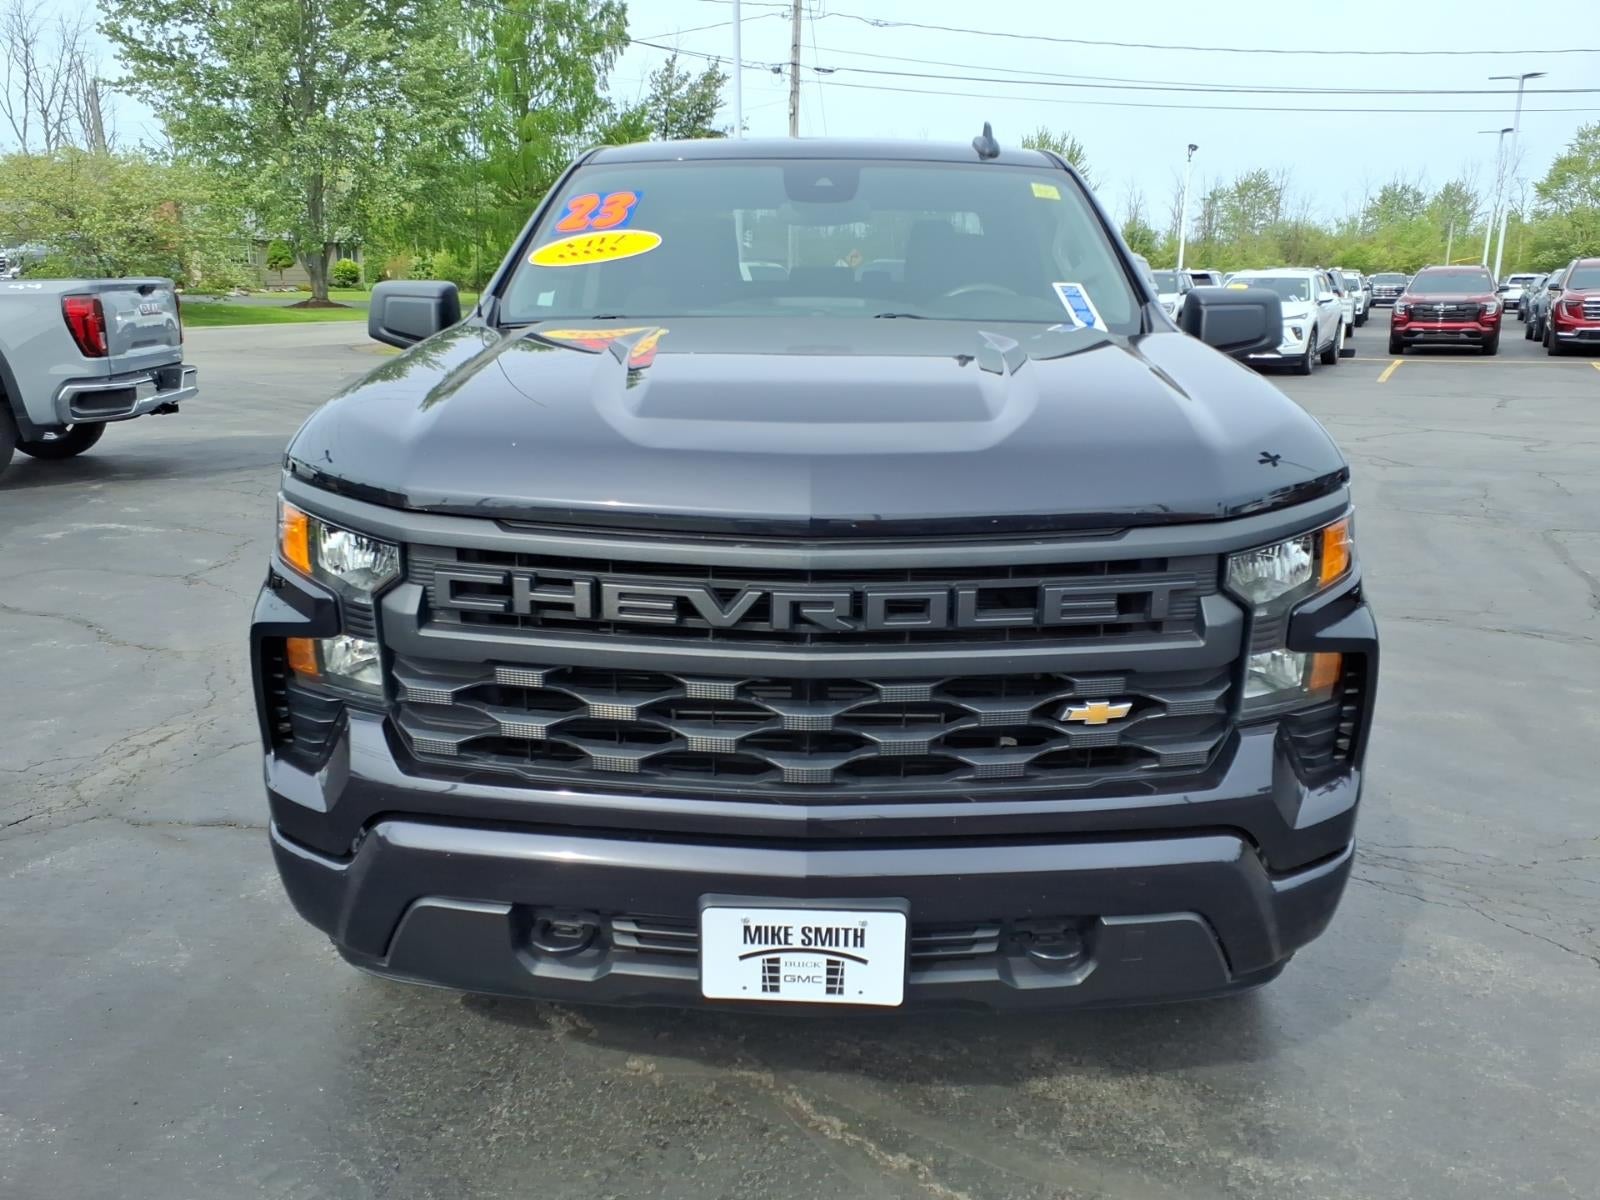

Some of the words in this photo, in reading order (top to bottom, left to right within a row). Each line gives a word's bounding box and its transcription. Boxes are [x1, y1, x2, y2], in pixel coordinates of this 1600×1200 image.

[555, 191, 637, 232] 23
[433, 567, 1197, 630] CHEVROLET
[743, 925, 793, 946] MIKE
[801, 926, 865, 948] SMITH
[784, 960, 821, 969] BUICK
[783, 974, 823, 984] GMC
